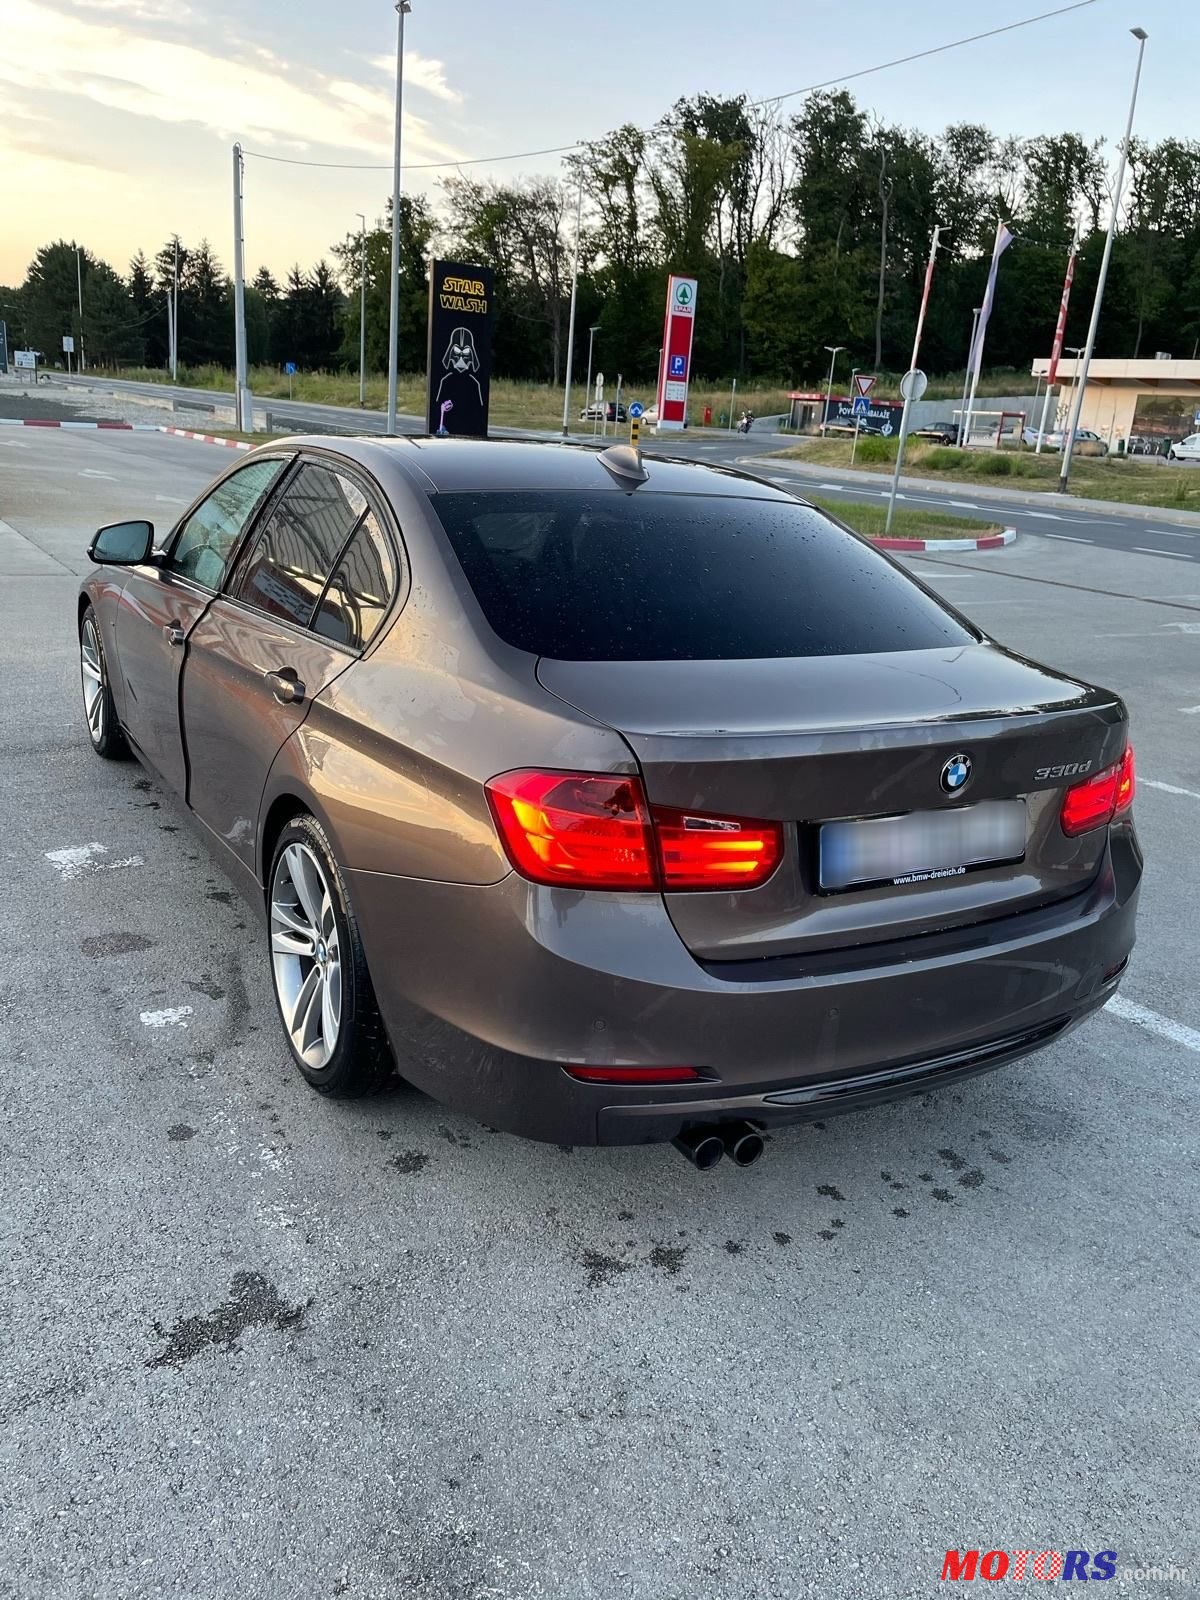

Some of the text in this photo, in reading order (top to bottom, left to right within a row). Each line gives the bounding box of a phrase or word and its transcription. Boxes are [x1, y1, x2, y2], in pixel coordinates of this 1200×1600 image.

[443, 277, 484, 296] STAR
[440, 294, 487, 314] WASH
[675, 358, 682, 369] P
[1034, 760, 1092, 778] 330d
[894, 866, 966, 885] www.bmw-dreieich.de
